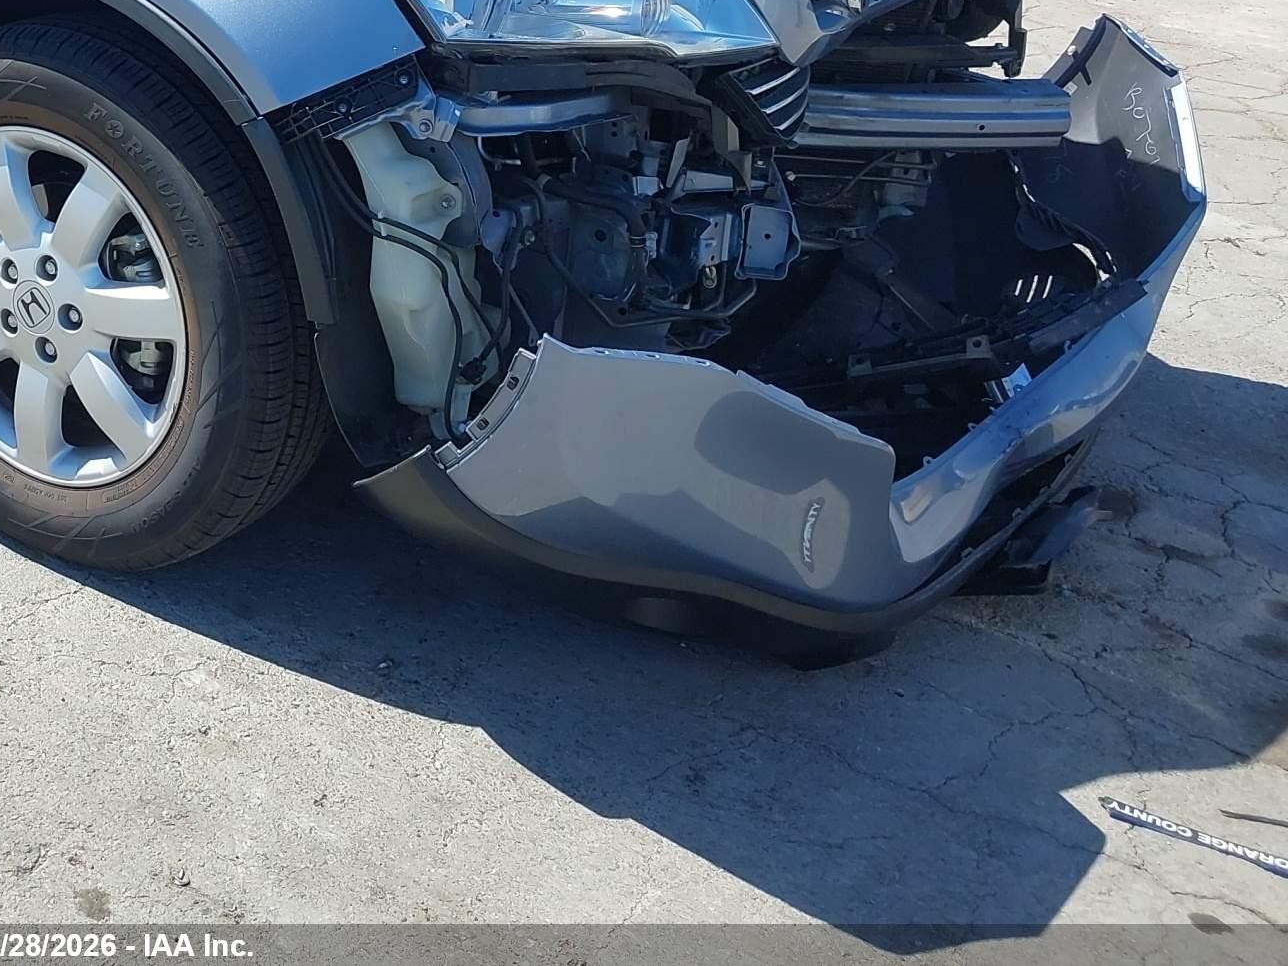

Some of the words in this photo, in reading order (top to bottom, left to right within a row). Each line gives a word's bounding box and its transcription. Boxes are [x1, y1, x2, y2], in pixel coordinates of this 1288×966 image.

[83, 101, 205, 250] FORTUNE
[1108, 800, 1194, 838] COUNTY
[1197, 831, 1288, 870] ORANGE
